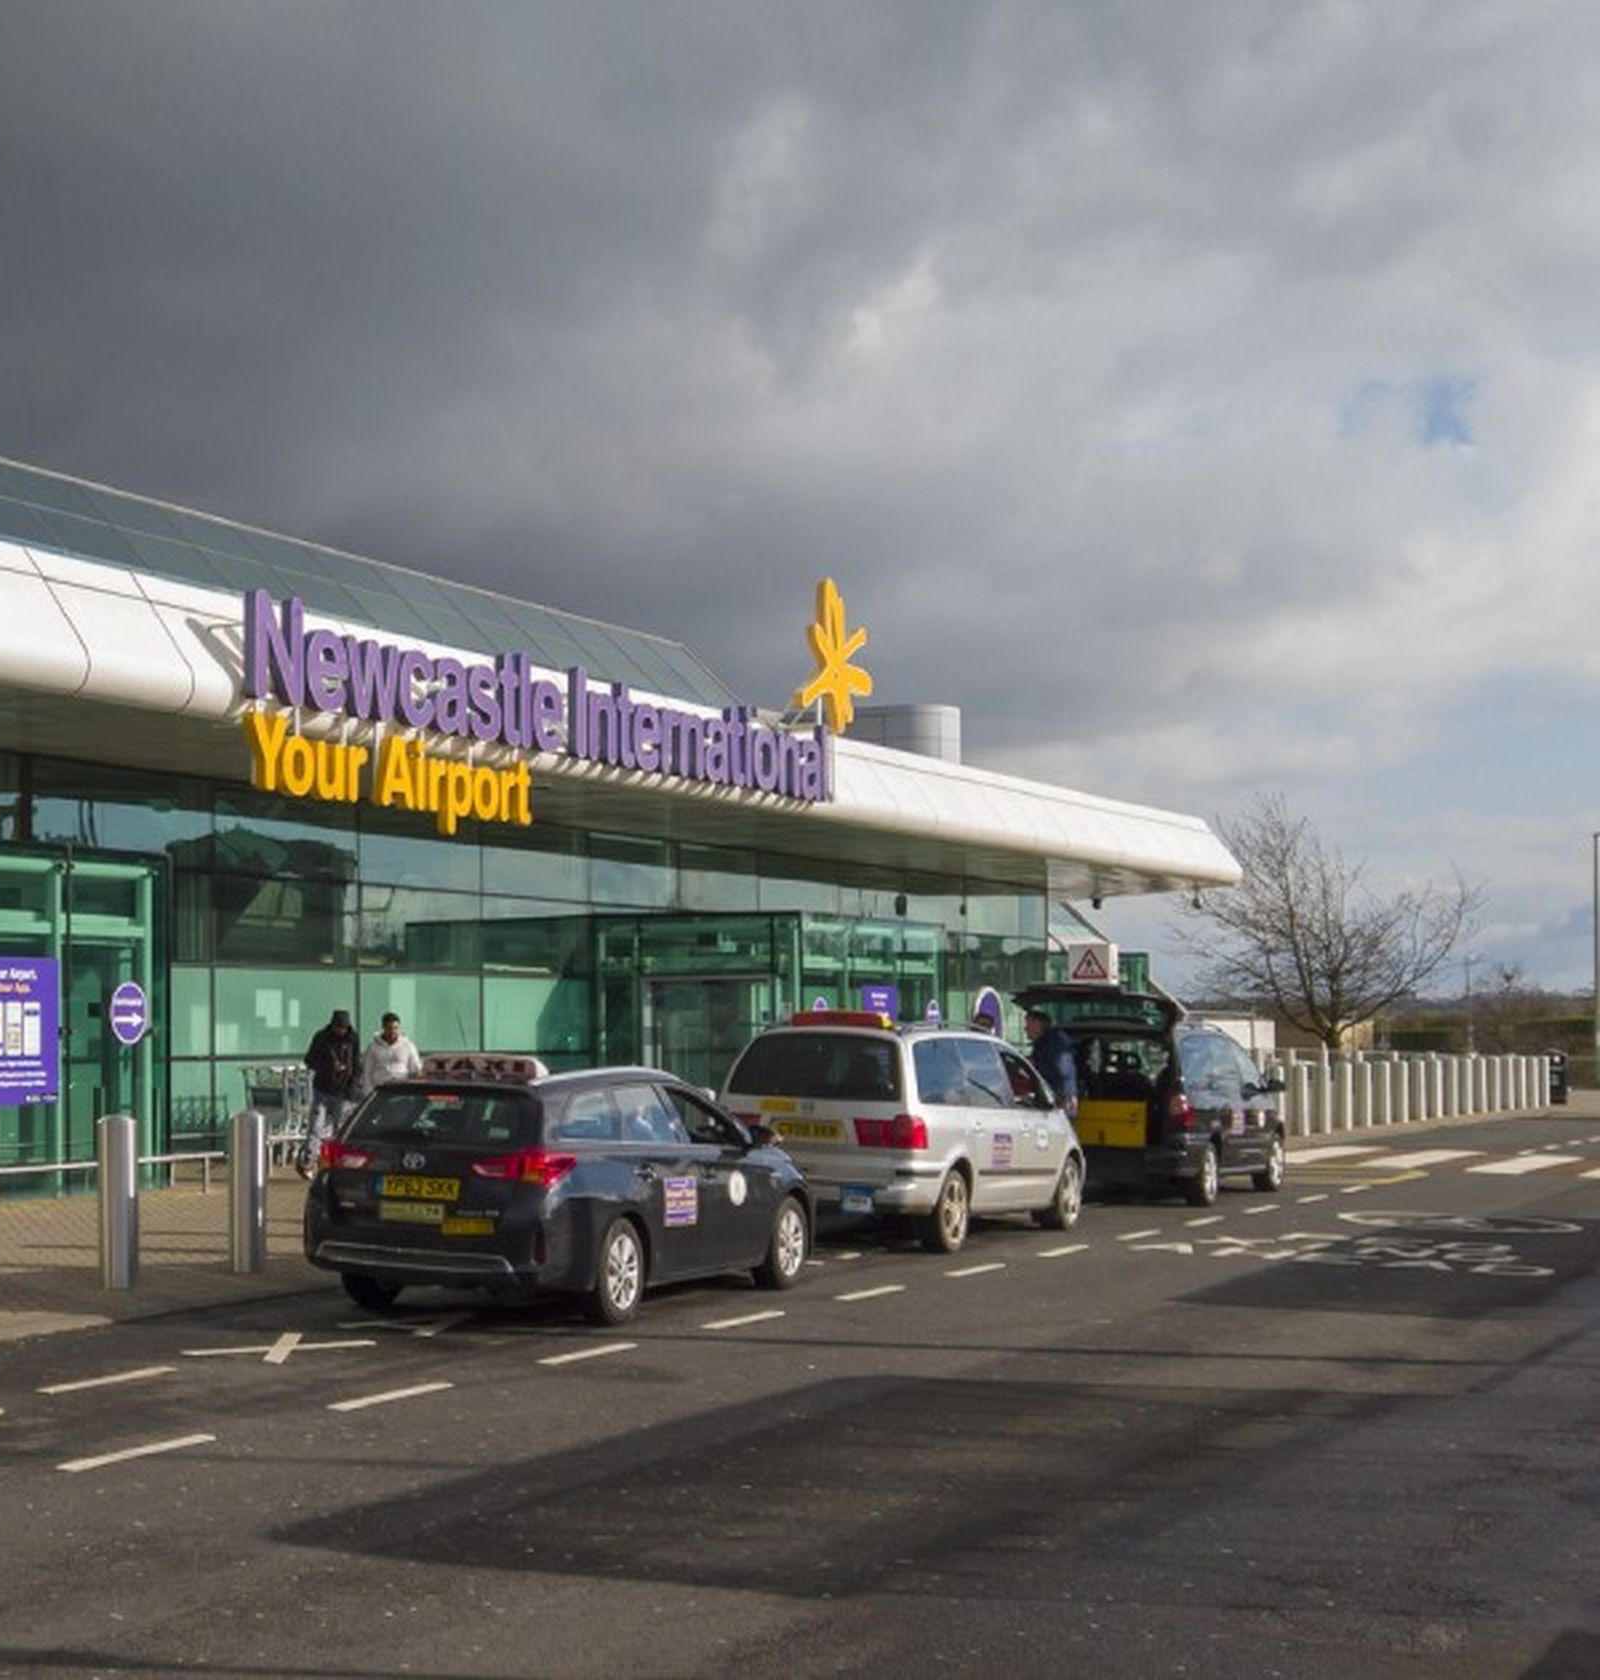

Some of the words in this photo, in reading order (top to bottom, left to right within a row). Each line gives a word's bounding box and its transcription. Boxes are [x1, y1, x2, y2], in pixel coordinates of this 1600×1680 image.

[244, 587, 564, 752] Newcastle
[568, 664, 834, 802] International
[244, 710, 368, 803] Your
[373, 734, 533, 835] Airport
[429, 1055, 528, 1073] TAXI
